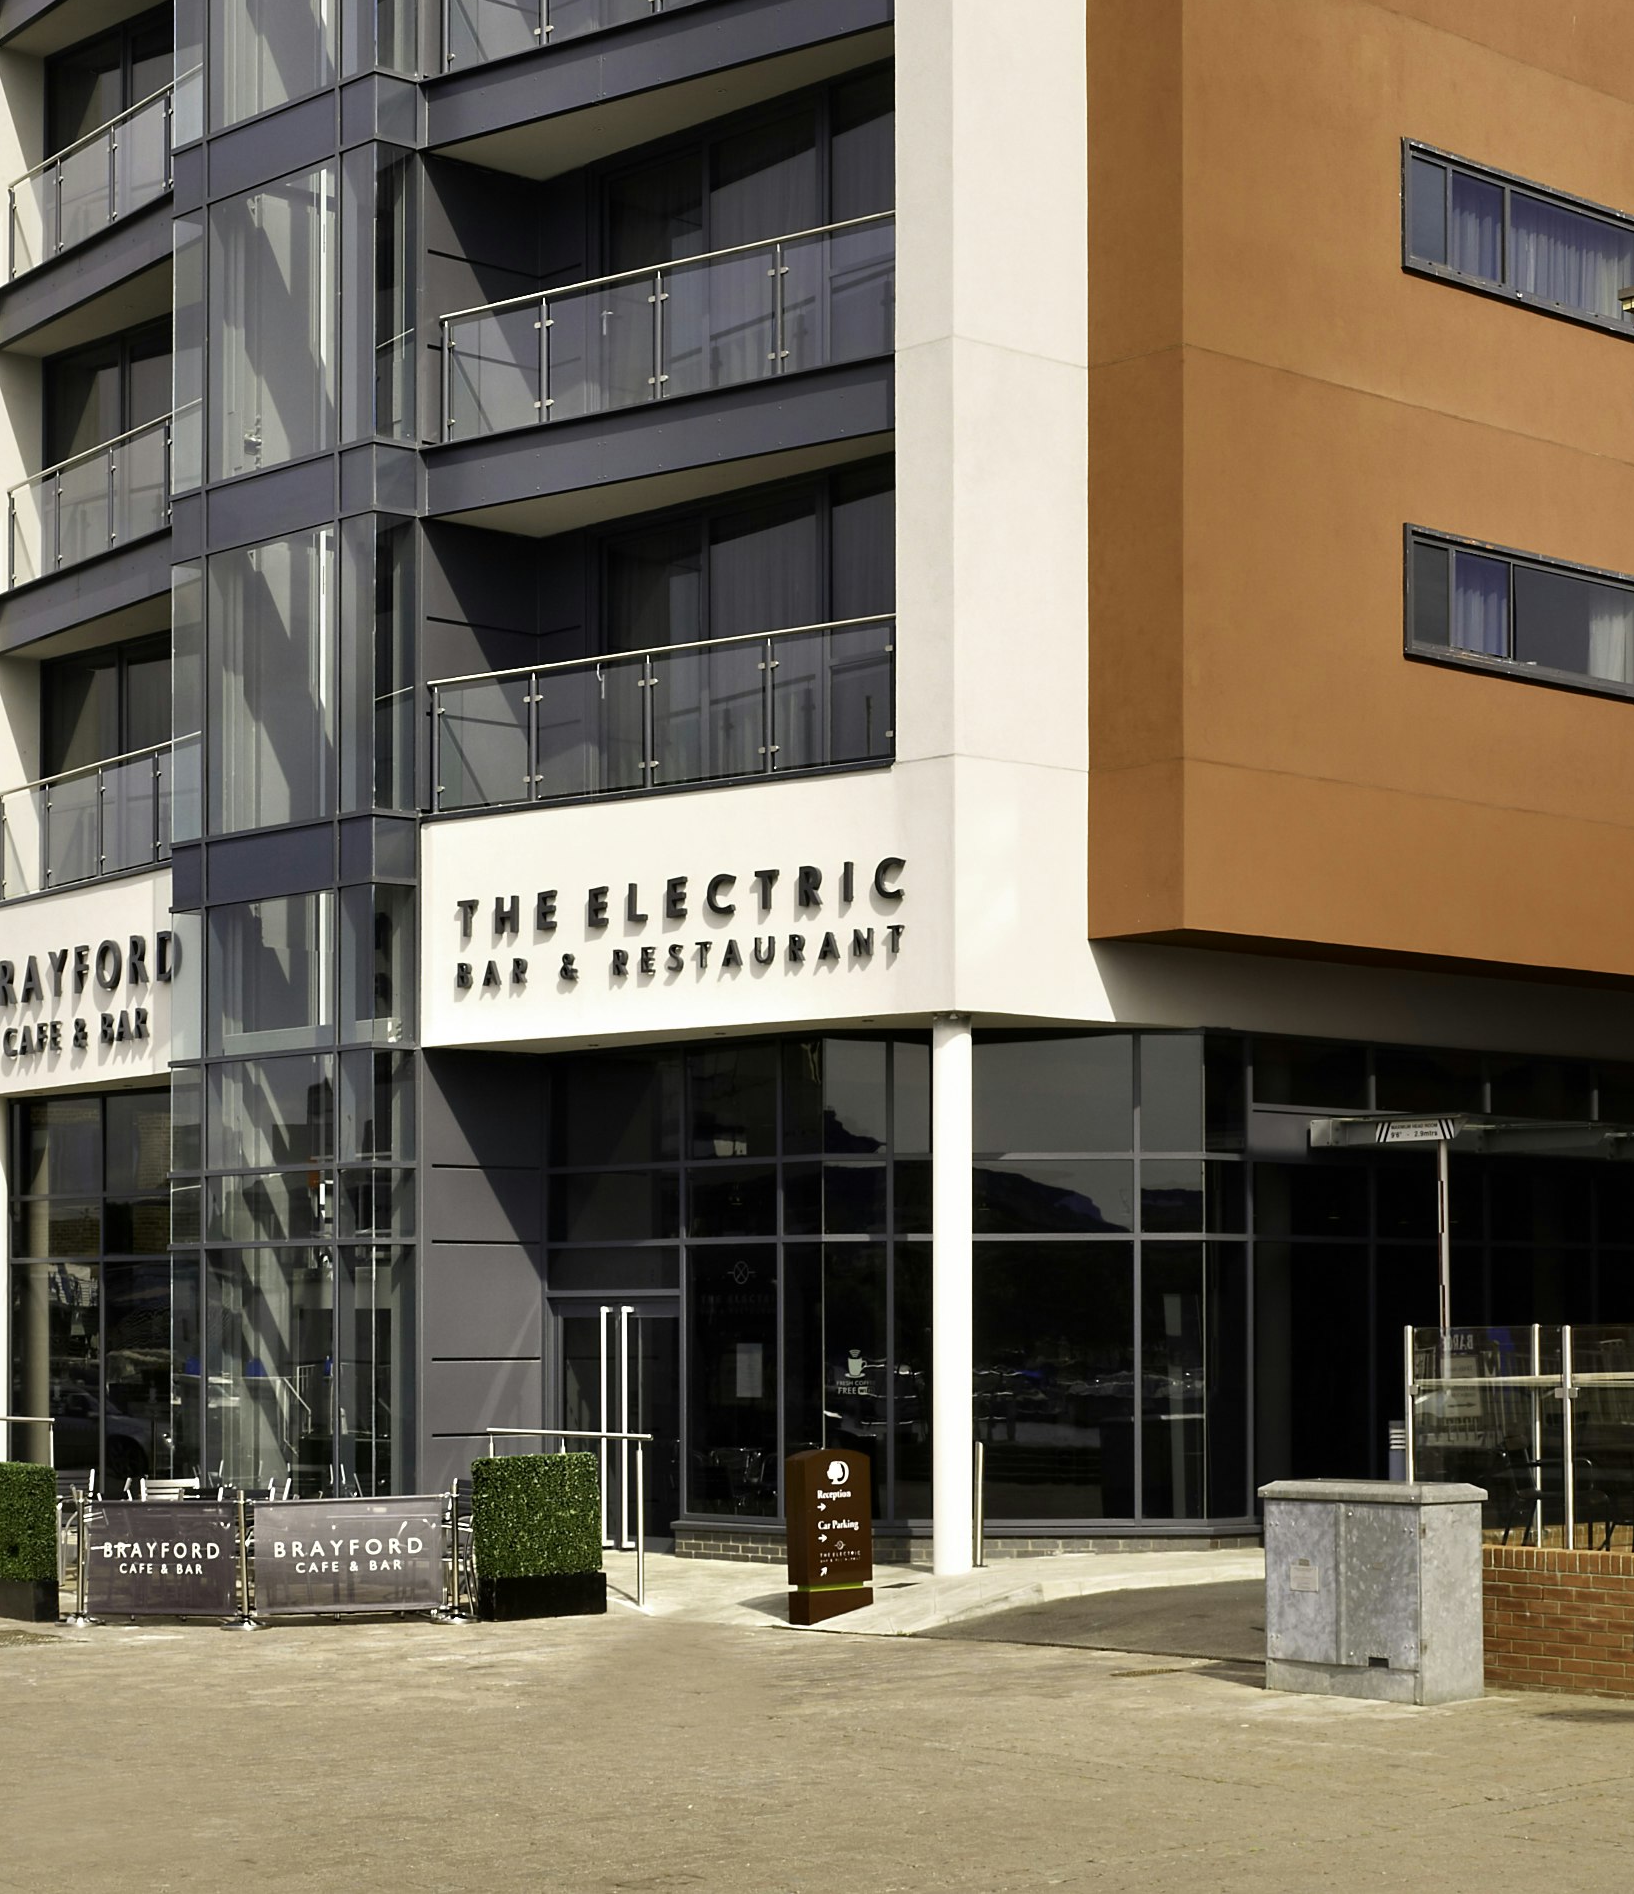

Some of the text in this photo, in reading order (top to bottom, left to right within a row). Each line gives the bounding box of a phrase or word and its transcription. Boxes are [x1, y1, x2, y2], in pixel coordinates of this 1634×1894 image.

[457, 857, 907, 938] THE ELECTRIC
[456, 924, 906, 989] BAR & RESTAURANT
[3, 1007, 150, 1058] CAFE & BAR
[817, 1489, 851, 1501] Reception
[817, 1519, 859, 1531] Car Parking
[103, 1541, 220, 1559] BRAYFORD
[274, 1537, 423, 1558] BRAYFORD
[119, 1563, 203, 1575] CAFE & BAR
[295, 1559, 402, 1573] CAFE & BAR
